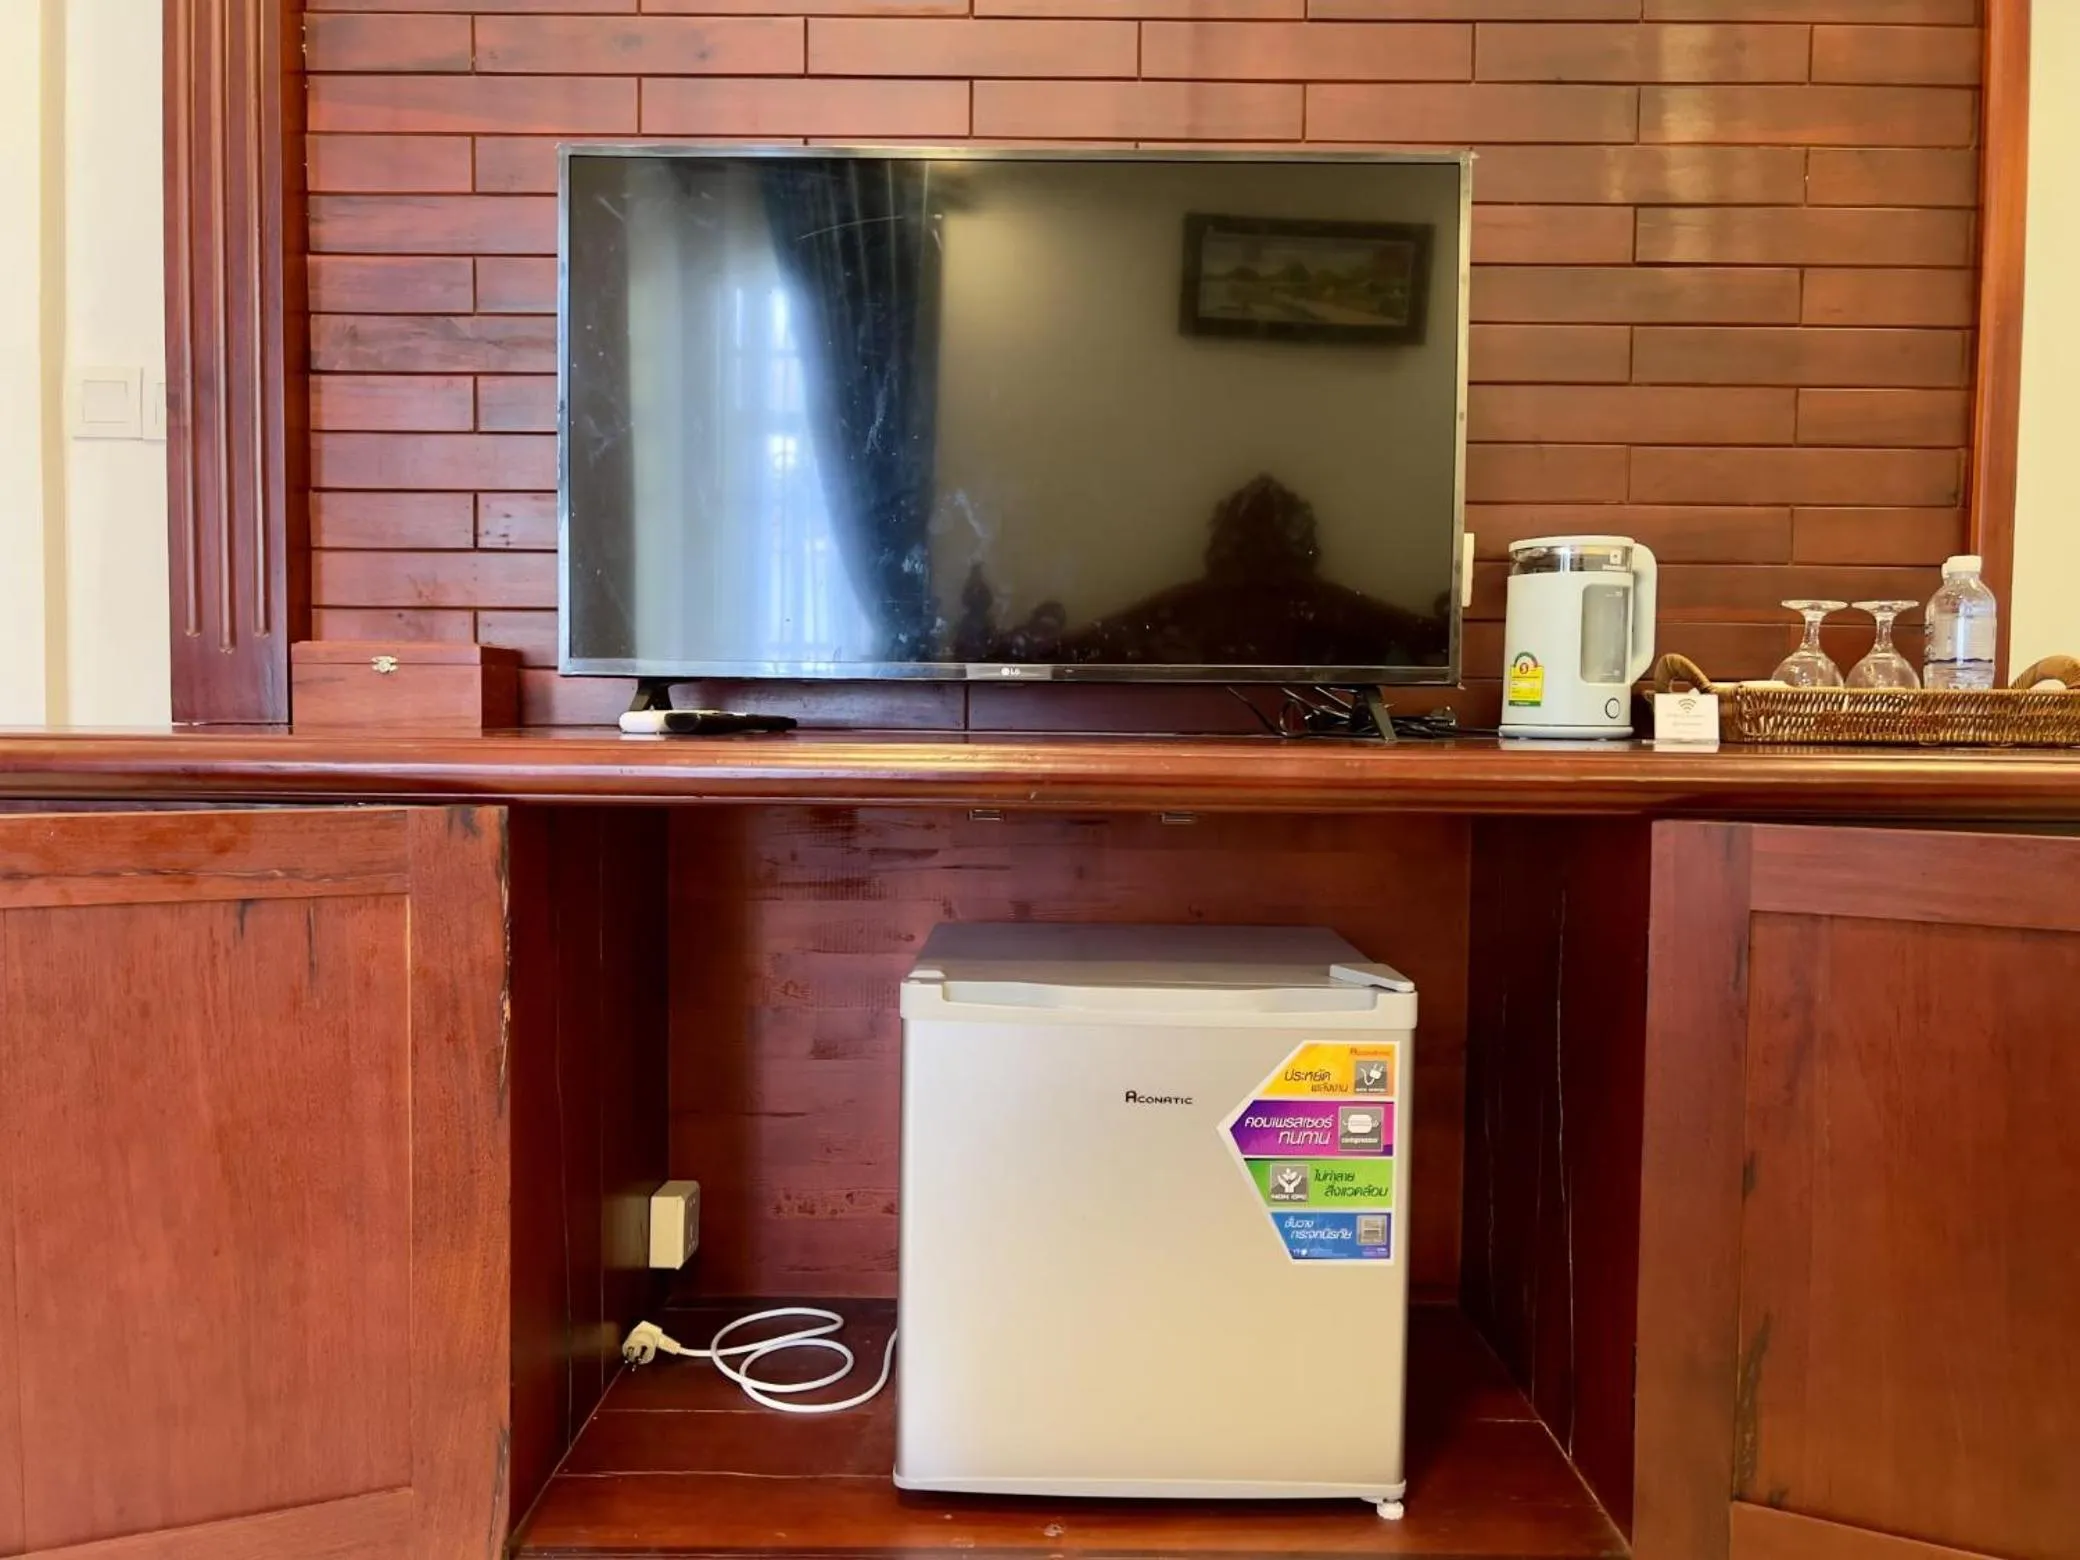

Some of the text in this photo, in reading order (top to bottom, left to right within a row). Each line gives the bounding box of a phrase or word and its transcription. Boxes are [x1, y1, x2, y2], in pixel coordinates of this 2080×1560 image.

[1284, 1068, 1332, 1082] ประหยัด
[1244, 1114, 1334, 1128] คอมเพรสเซอร์
[1278, 1130, 1331, 1145] ทนทาน
